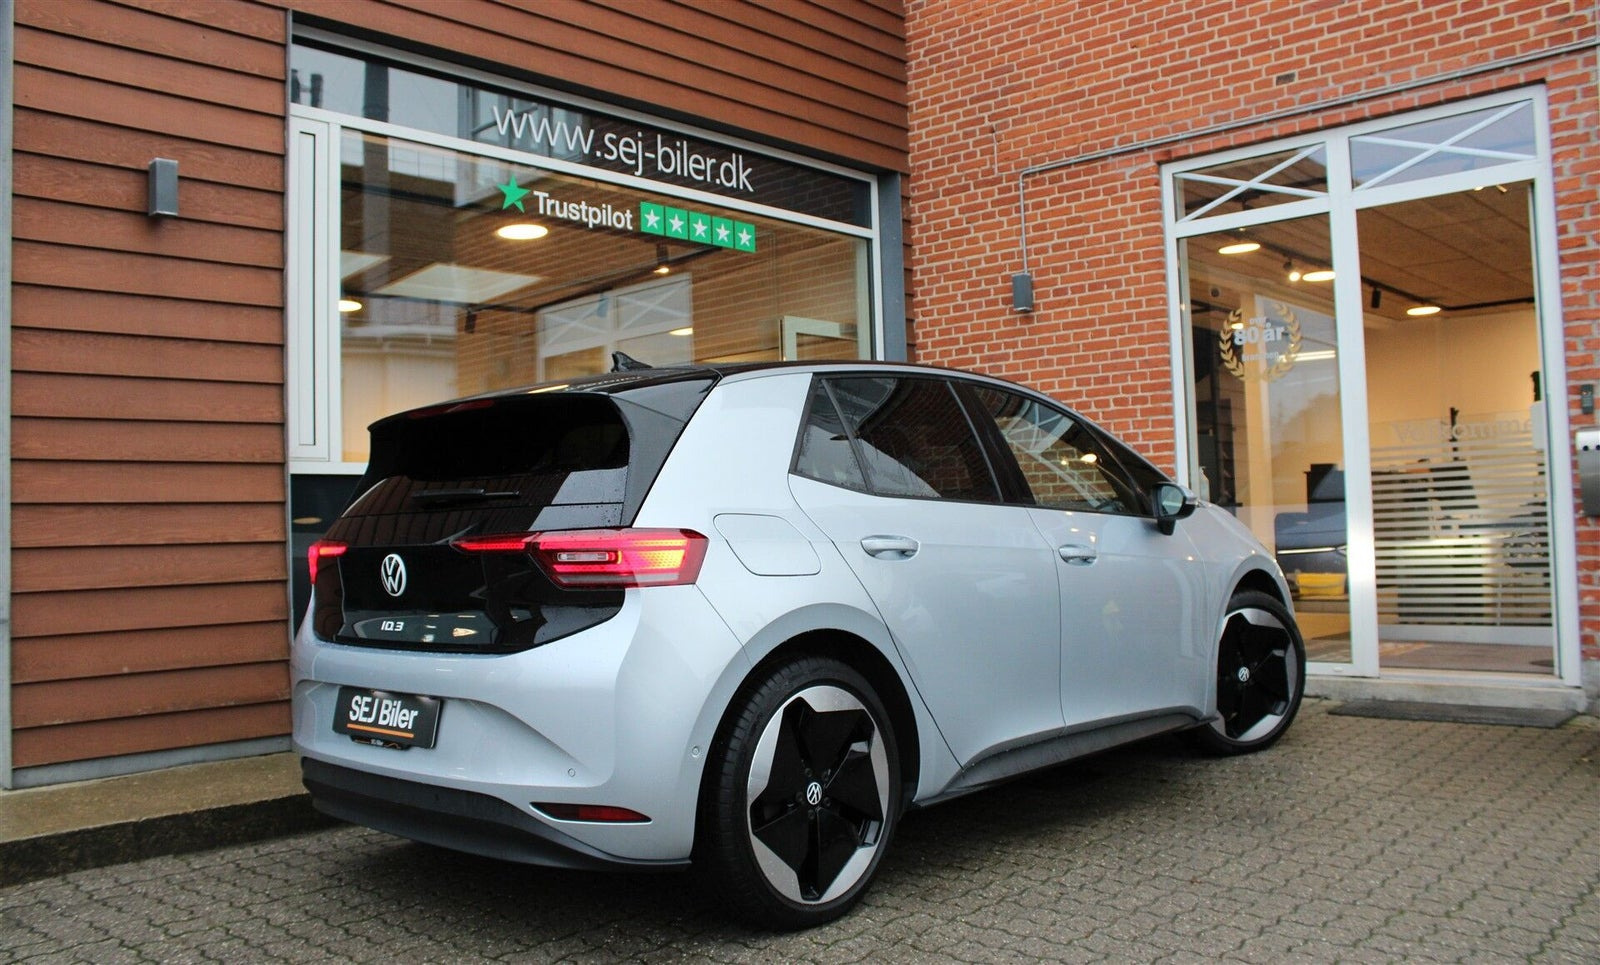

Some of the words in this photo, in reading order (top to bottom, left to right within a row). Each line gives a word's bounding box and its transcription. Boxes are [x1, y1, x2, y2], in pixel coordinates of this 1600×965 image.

[493, 105, 754, 192] www.sej-biler.dk
[533, 190, 633, 230] Trustpilot
[1233, 326, 1259, 346] 80
[1263, 322, 1285, 342] år
[349, 695, 379, 723] SEJ
[378, 699, 418, 730] Biler
